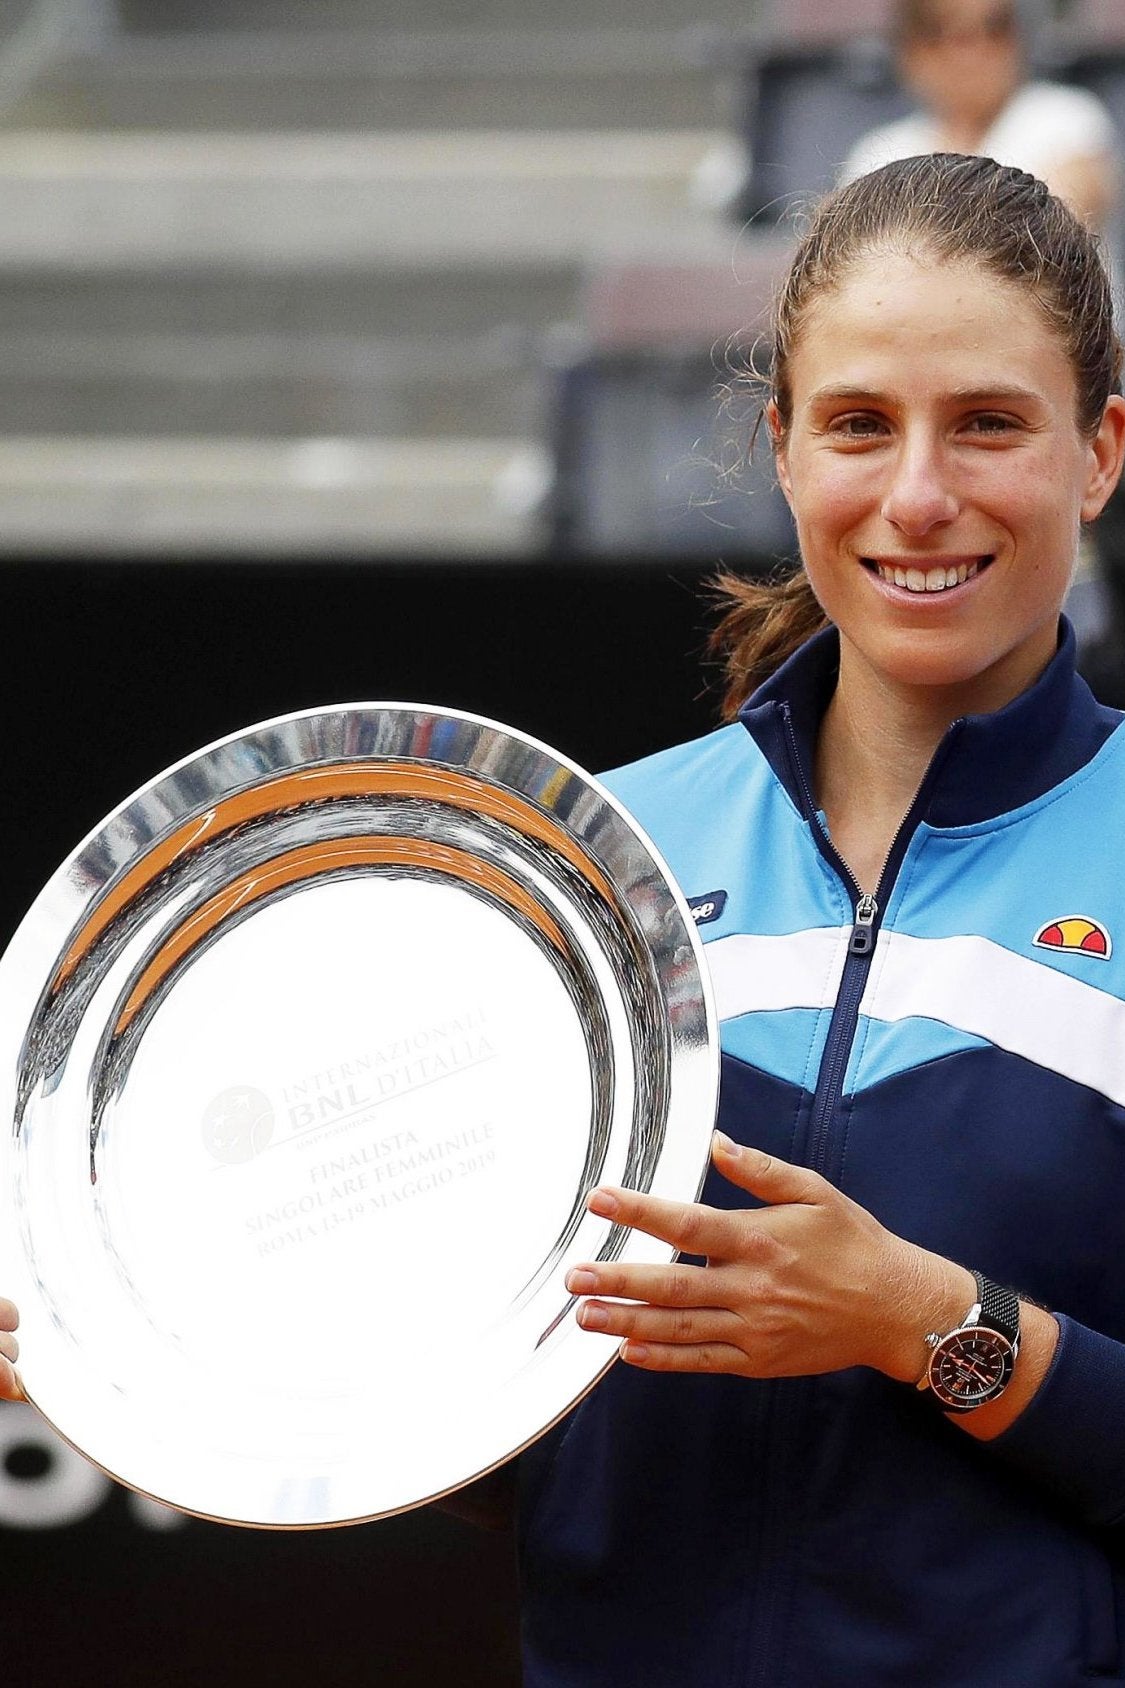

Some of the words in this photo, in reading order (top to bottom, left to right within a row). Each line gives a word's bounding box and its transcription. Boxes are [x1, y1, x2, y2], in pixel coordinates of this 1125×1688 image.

[281, 1006, 487, 1102] INTERNAZIONALI
[288, 1083, 371, 1130] BNL
[375, 1034, 495, 1096] D'ITALIA
[245, 1172, 368, 1236] SINGOLARE
[374, 1121, 494, 1183] FEMMINILE
[257, 1225, 318, 1259] ROMA
[369, 1168, 453, 1212] MAGGIO
[457, 1149, 496, 1177] 2019
[309, 1130, 419, 1184] FINALISTA
